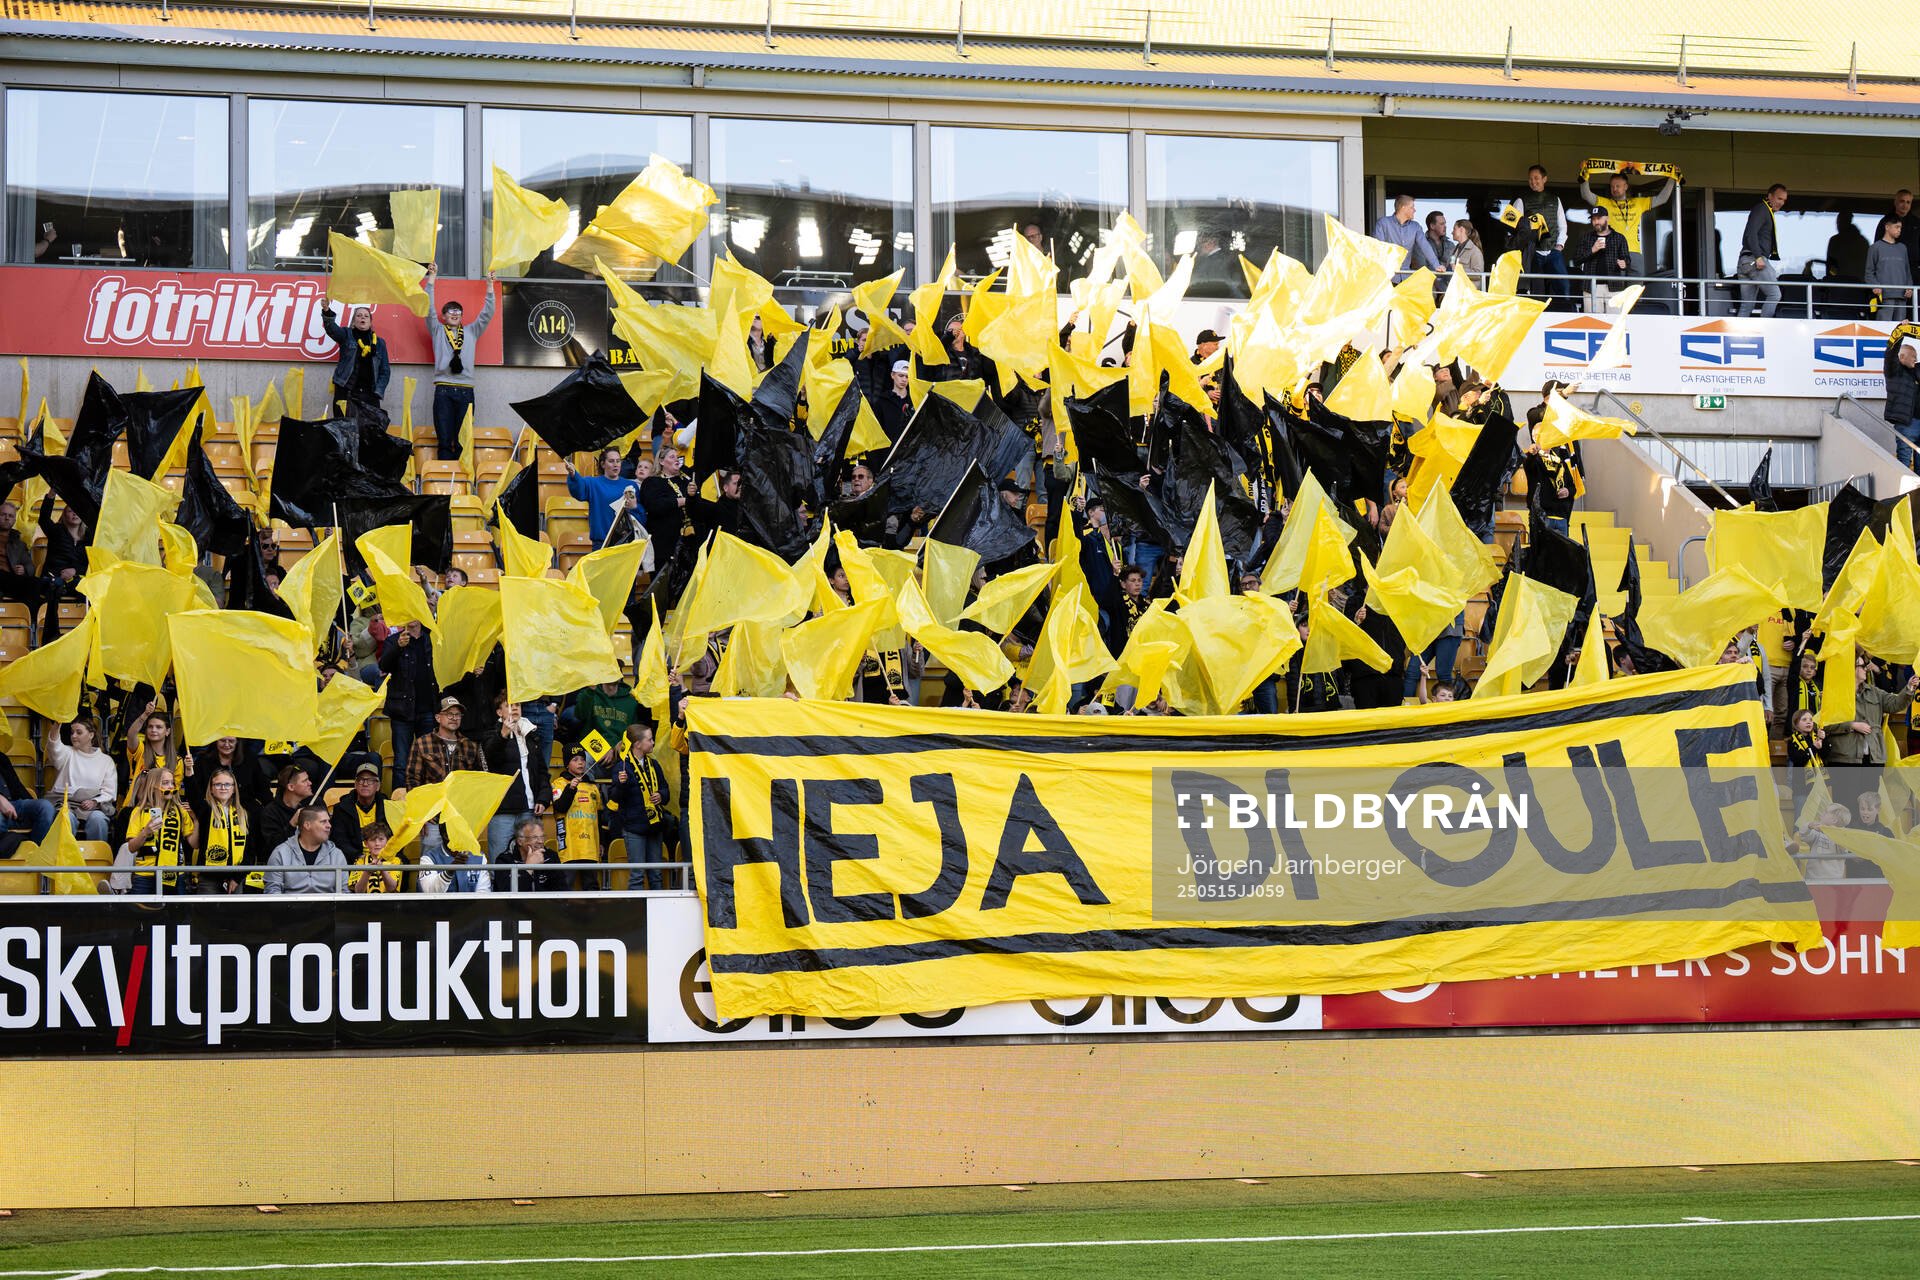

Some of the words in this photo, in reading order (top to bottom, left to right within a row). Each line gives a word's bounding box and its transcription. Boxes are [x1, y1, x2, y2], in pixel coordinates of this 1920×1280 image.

[1644, 163, 1674, 173] KLAS
[89, 281, 371, 354] fotriktig
[538, 315, 566, 334] A14
[1681, 335, 1765, 365] CA
[1559, 371, 1617, 381] FASTGHETER
[1619, 373, 1631, 381] AB
[1681, 374, 1694, 383] CA
[1695, 374, 1753, 384] FASTIGHETER
[1754, 376, 1766, 384] AB
[1814, 377, 1827, 386] CA
[1828, 378, 1884, 387] FASTIGHETER
[700, 772, 1111, 930] HEJA
[1171, 768, 1319, 902] DI
[1385, 721, 1768, 888] GULE
[1769, 934, 1906, 976] SOHN
[0, 920, 628, 1047] Skyltproduktion
